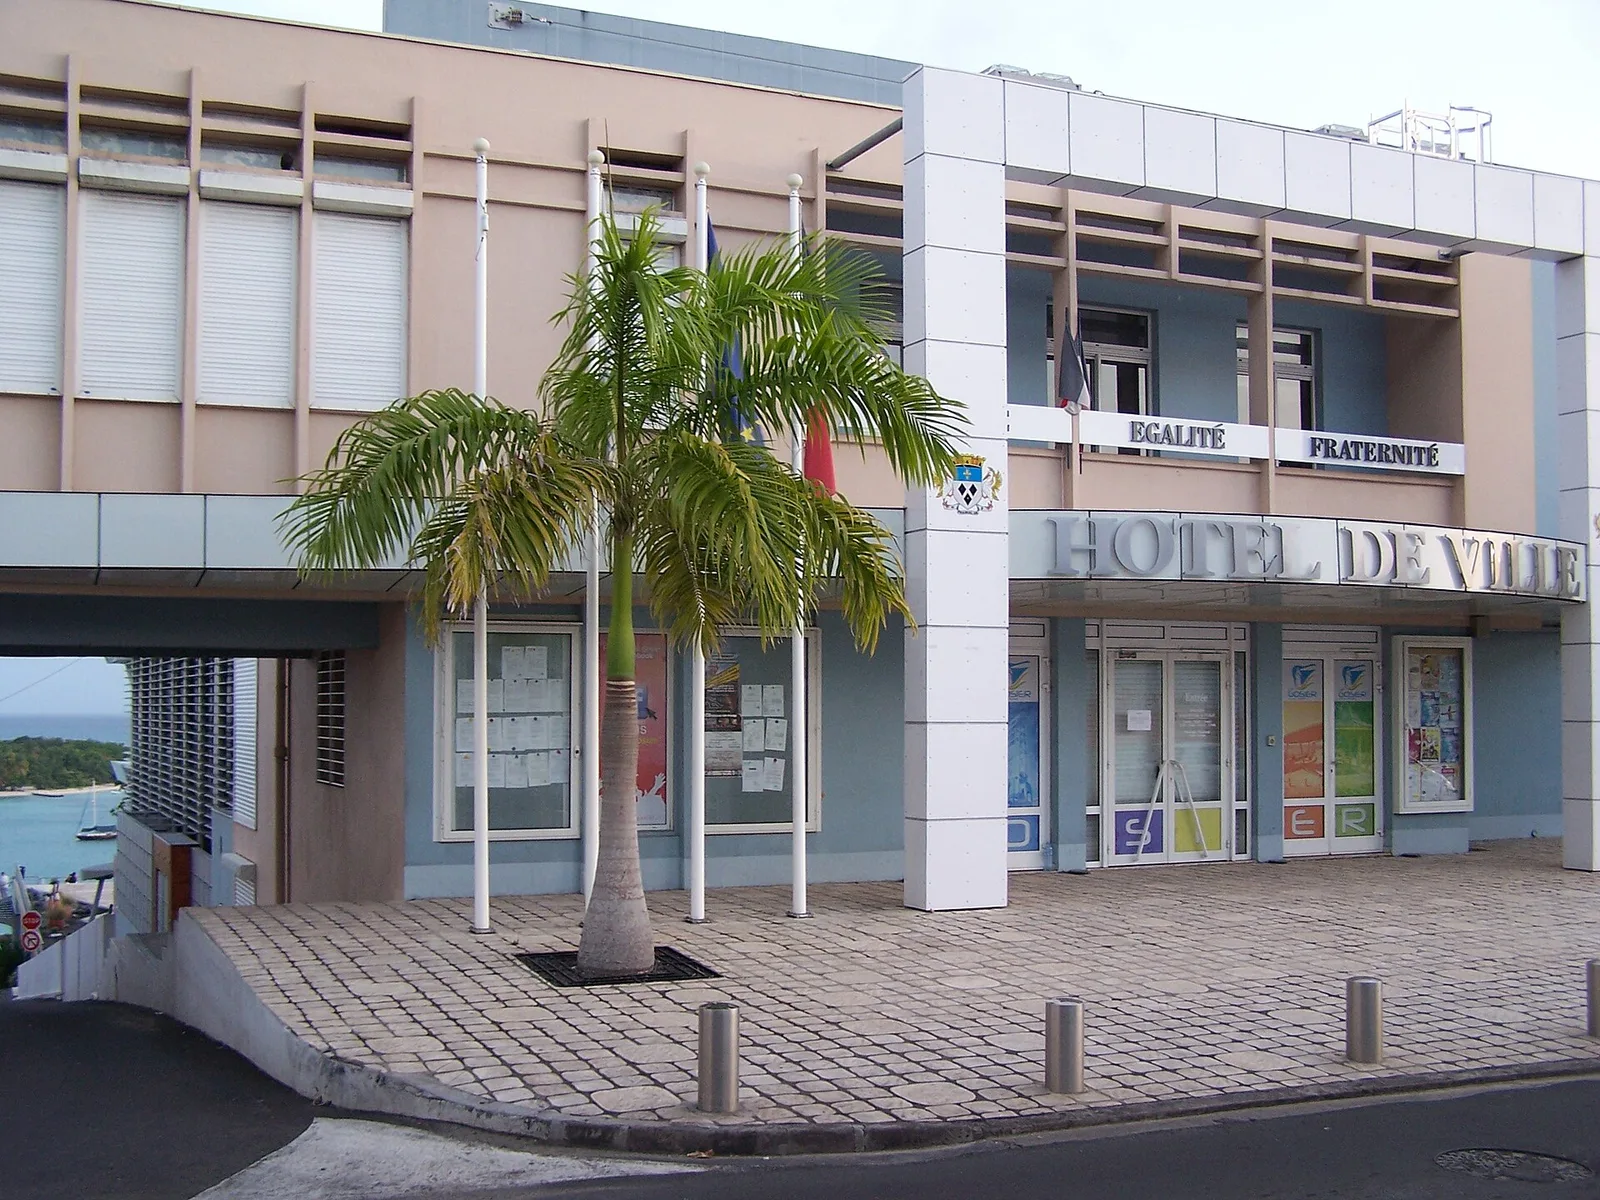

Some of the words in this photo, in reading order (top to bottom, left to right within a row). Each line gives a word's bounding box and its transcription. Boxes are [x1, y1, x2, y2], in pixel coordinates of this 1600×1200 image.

[1129, 420, 1227, 450] EGALITÉ
[1310, 436, 1440, 467] FRATERNITÉ
[1046, 516, 1322, 581] HOTEL
[1339, 526, 1431, 585] DE
[1436, 534, 1582, 599] VILLE
[1341, 807, 1367, 834] R
[23, 917, 40, 925] STOP
